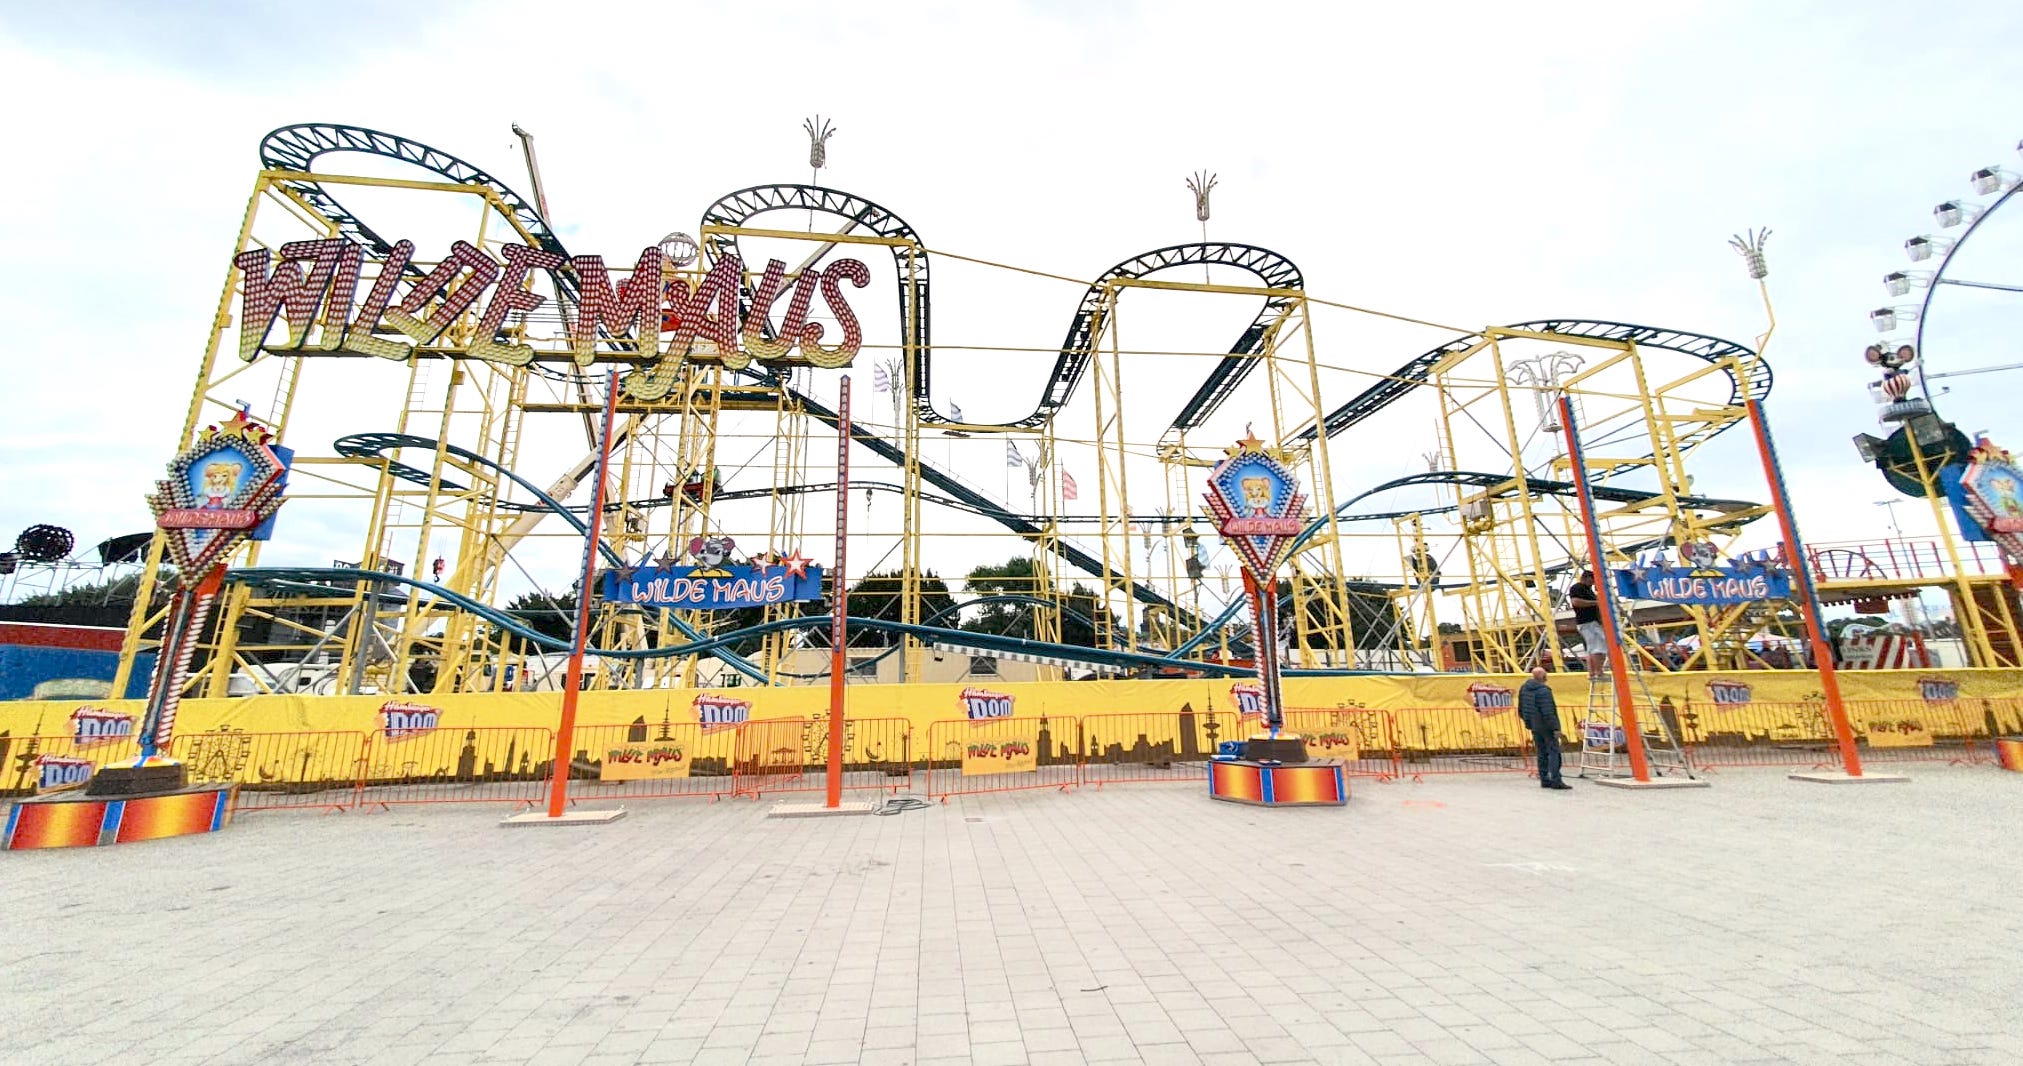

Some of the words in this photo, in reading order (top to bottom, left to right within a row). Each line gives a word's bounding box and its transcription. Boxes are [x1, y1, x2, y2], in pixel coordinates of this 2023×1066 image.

[234, 238, 565, 364] WILDE
[571, 246, 871, 400] MAUS
[712, 576, 785, 602] MAUS
[1709, 577, 1769, 599] MAUS
